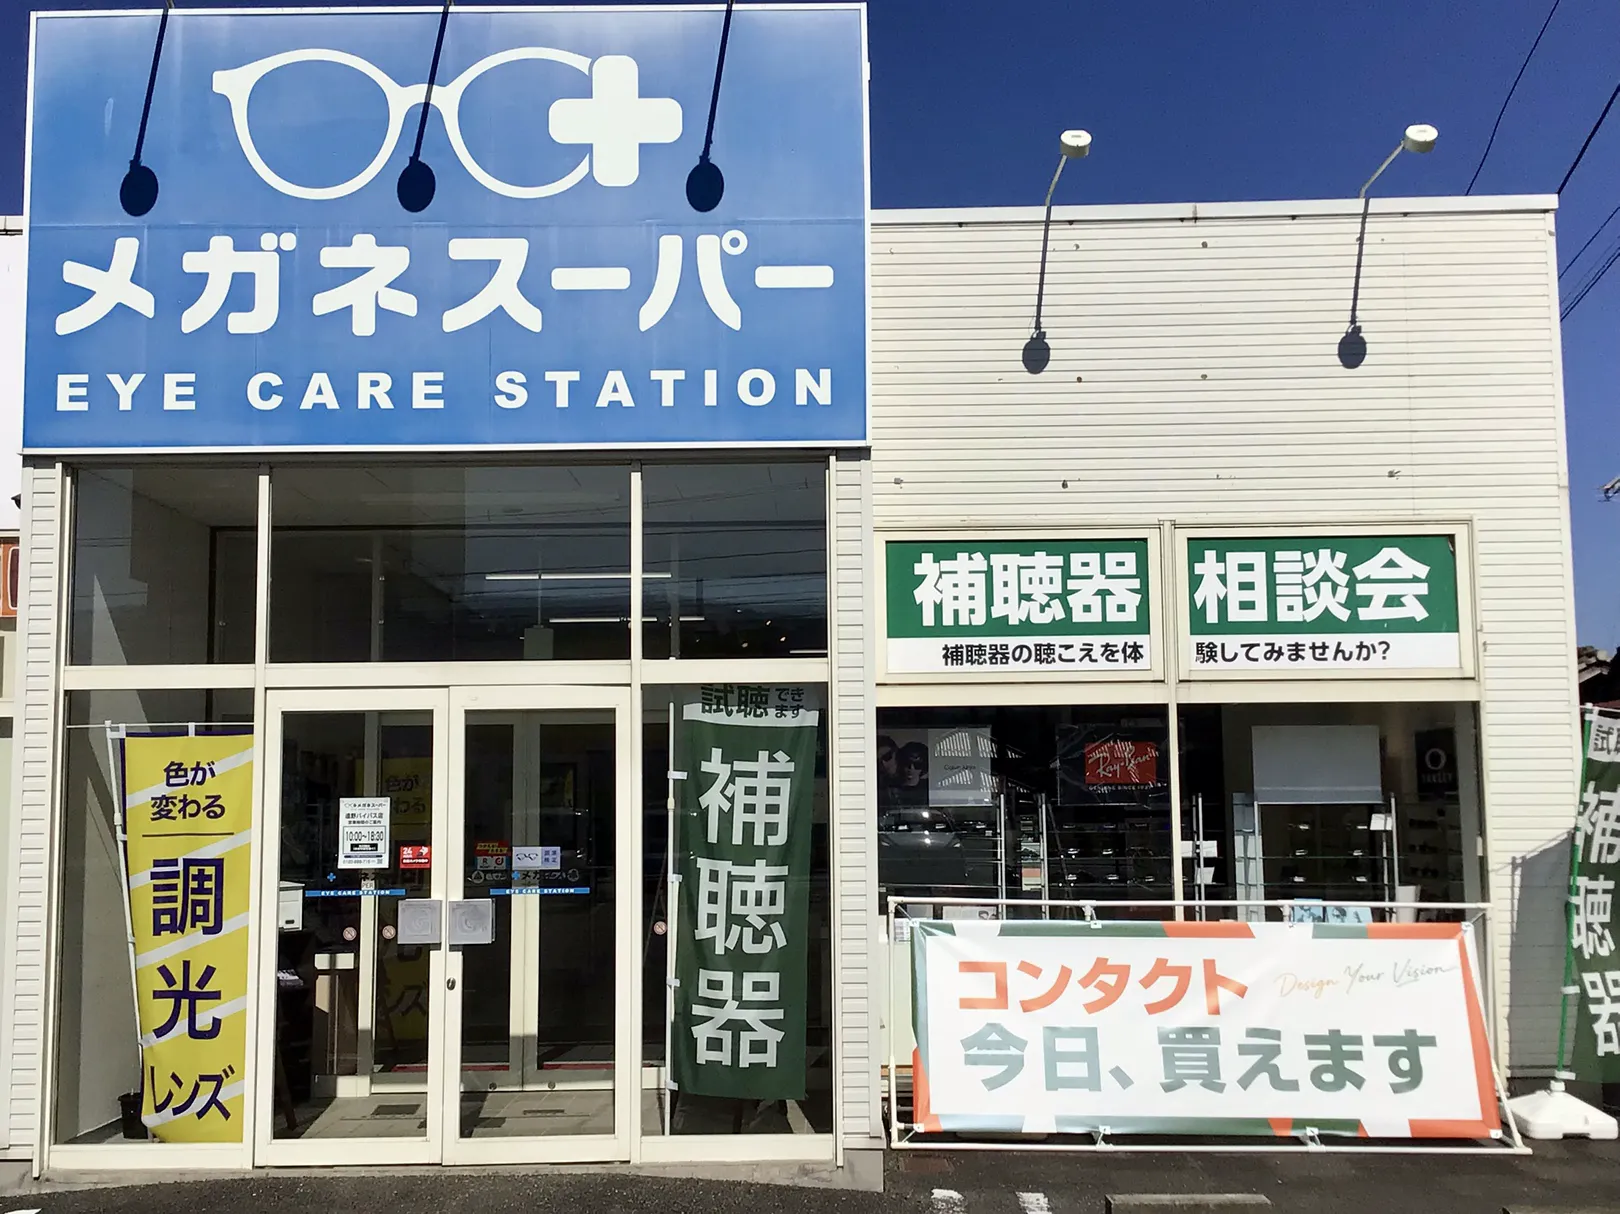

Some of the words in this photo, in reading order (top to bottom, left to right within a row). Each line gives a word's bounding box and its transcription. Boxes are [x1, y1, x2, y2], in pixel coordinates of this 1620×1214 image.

[55, 230, 834, 337] メガネスーパー
[56, 372, 197, 412] EYE
[246, 371, 446, 411] CARE
[494, 368, 832, 408] STATION
[913, 551, 1142, 626] 補聴器
[1193, 547, 1431, 624] 相談会
[942, 641, 1144, 666] 補聴器の聴こえを体
[701, 683, 770, 718] 試聴
[1593, 724, 1620, 755] 試
[163, 761, 216, 787] 色が
[150, 794, 226, 821] 変わる
[691, 747, 795, 1068] 補聴器
[958, 958, 1249, 1015] コンタクト
[1274, 972, 1338, 999] Design
[1343, 962, 1385, 995] Your
[1392, 958, 1460, 988] Vision
[960, 1022, 1438, 1095] 今日、買えます
[150, 1064, 236, 1121] レンズ
